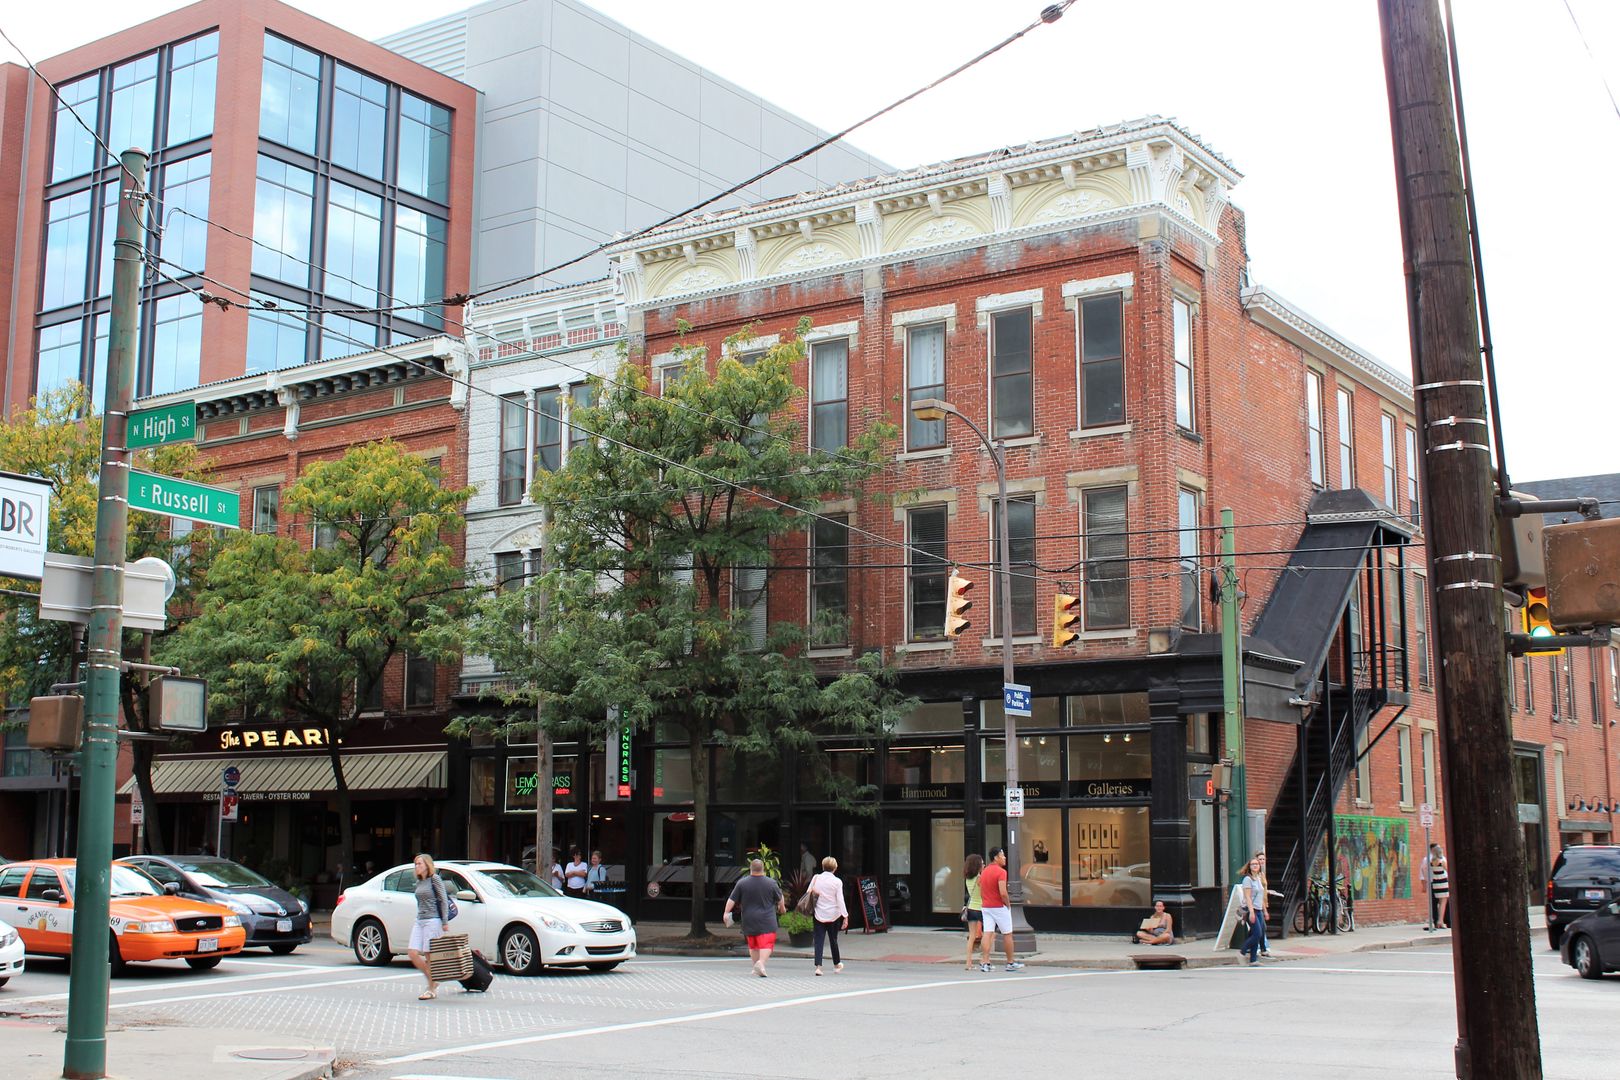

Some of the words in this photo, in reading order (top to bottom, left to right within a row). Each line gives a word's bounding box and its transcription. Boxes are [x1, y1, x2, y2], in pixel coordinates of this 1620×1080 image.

[133, 425, 139, 436] N
[143, 414, 176, 442] High
[181, 416, 190, 428] St
[140, 486, 146, 497] E
[152, 484, 209, 514] Russell
[217, 502, 226, 513] St
[1, 497, 34, 537] BR
[1011, 699, 1024, 709] Parking
[1013, 691, 1024, 700] Public
[220, 730, 240, 749] The
[268, 792, 292, 800] OYSTER
[292, 792, 311, 800] ROOM
[901, 785, 947, 798] Hammond
[1087, 782, 1133, 795] Galleries
[27, 910, 48, 925] ORANGE
[48, 913, 58, 928] CAB
